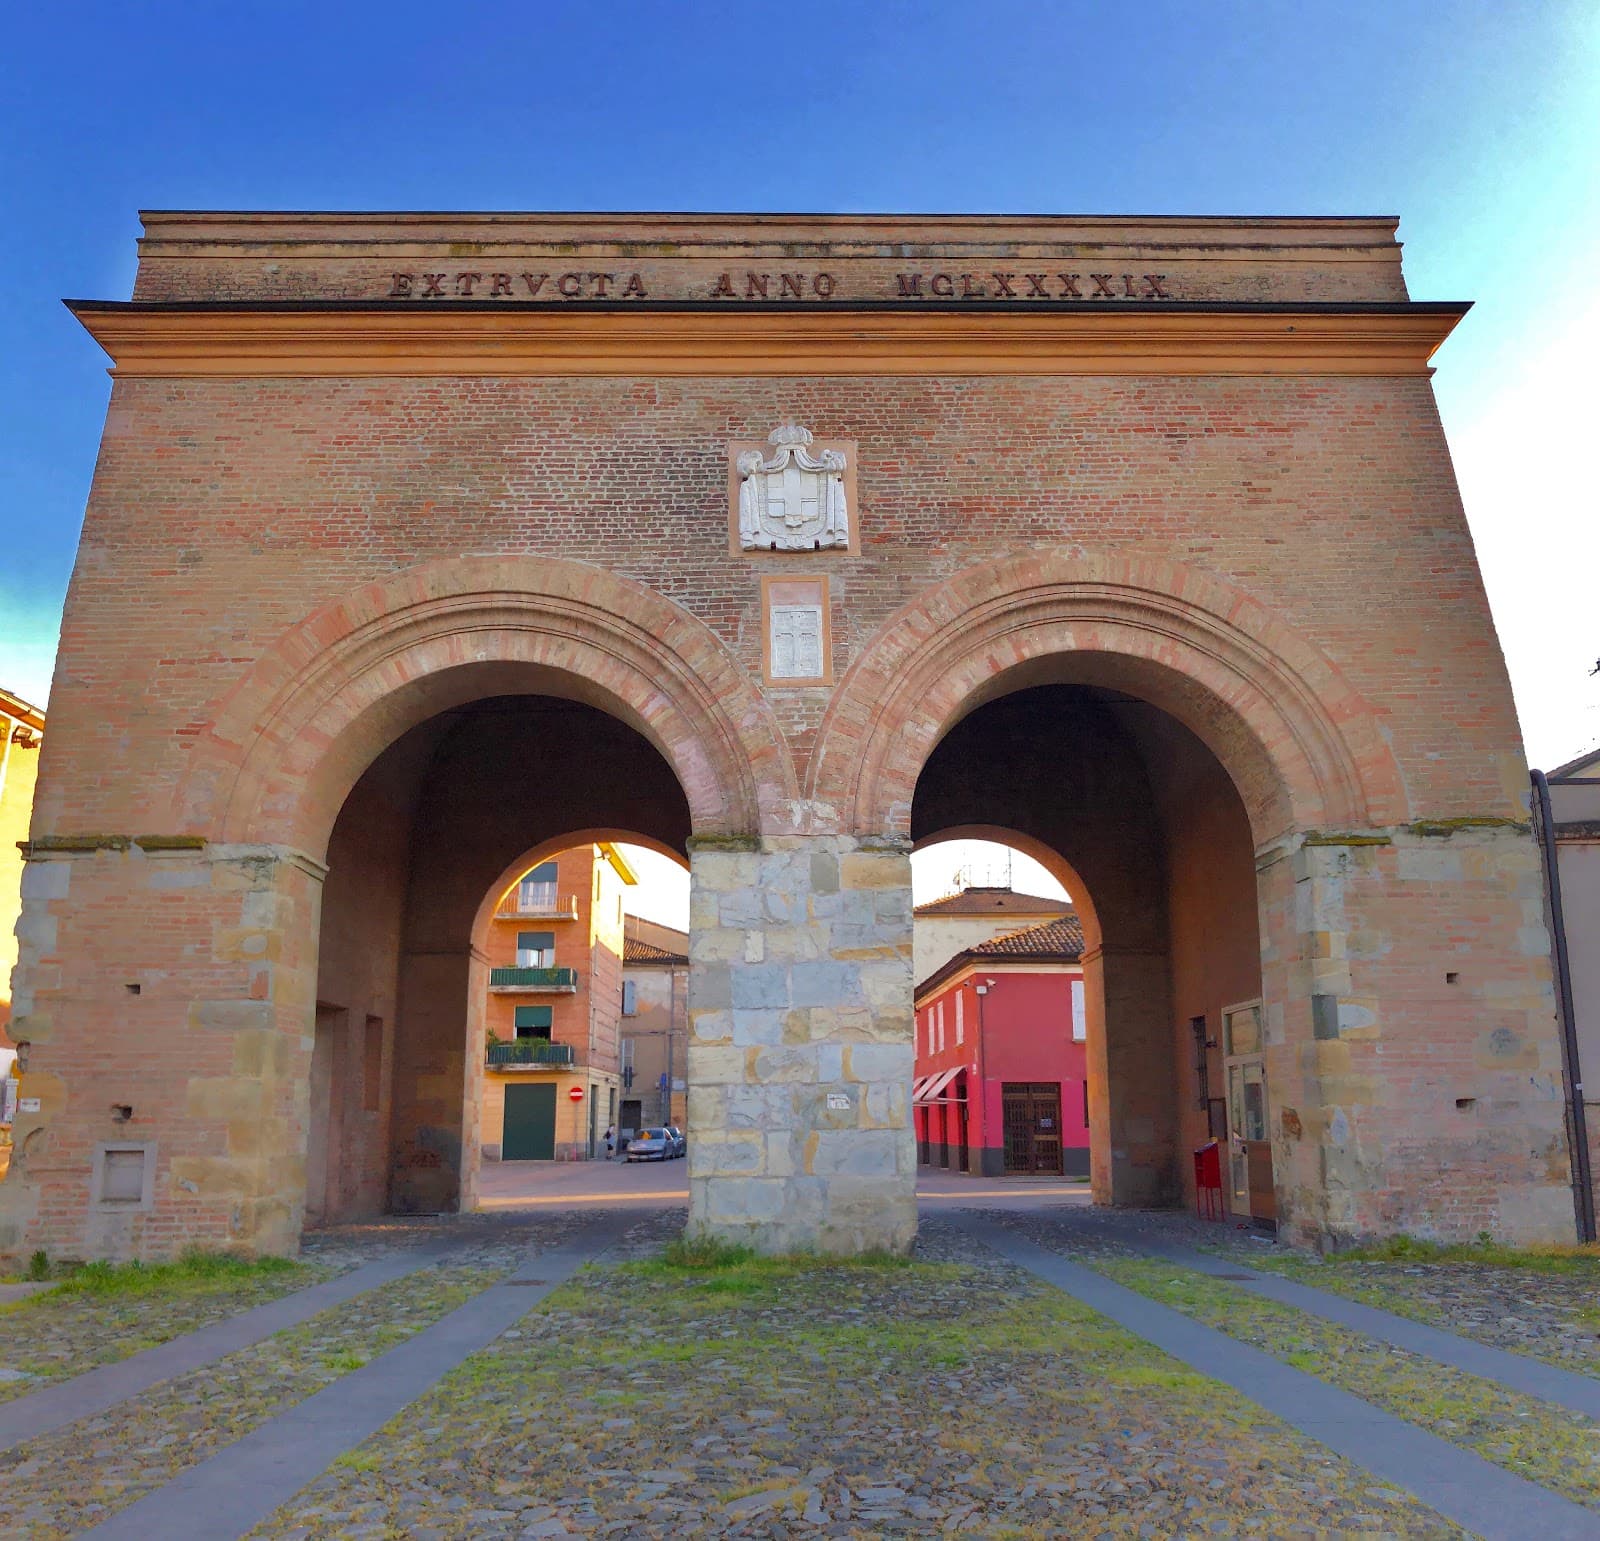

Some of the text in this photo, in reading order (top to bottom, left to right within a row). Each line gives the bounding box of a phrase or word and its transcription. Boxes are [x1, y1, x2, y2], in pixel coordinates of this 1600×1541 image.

[390, 272, 1169, 297] EXTRVCTA ANNO MCLXXXXIX
